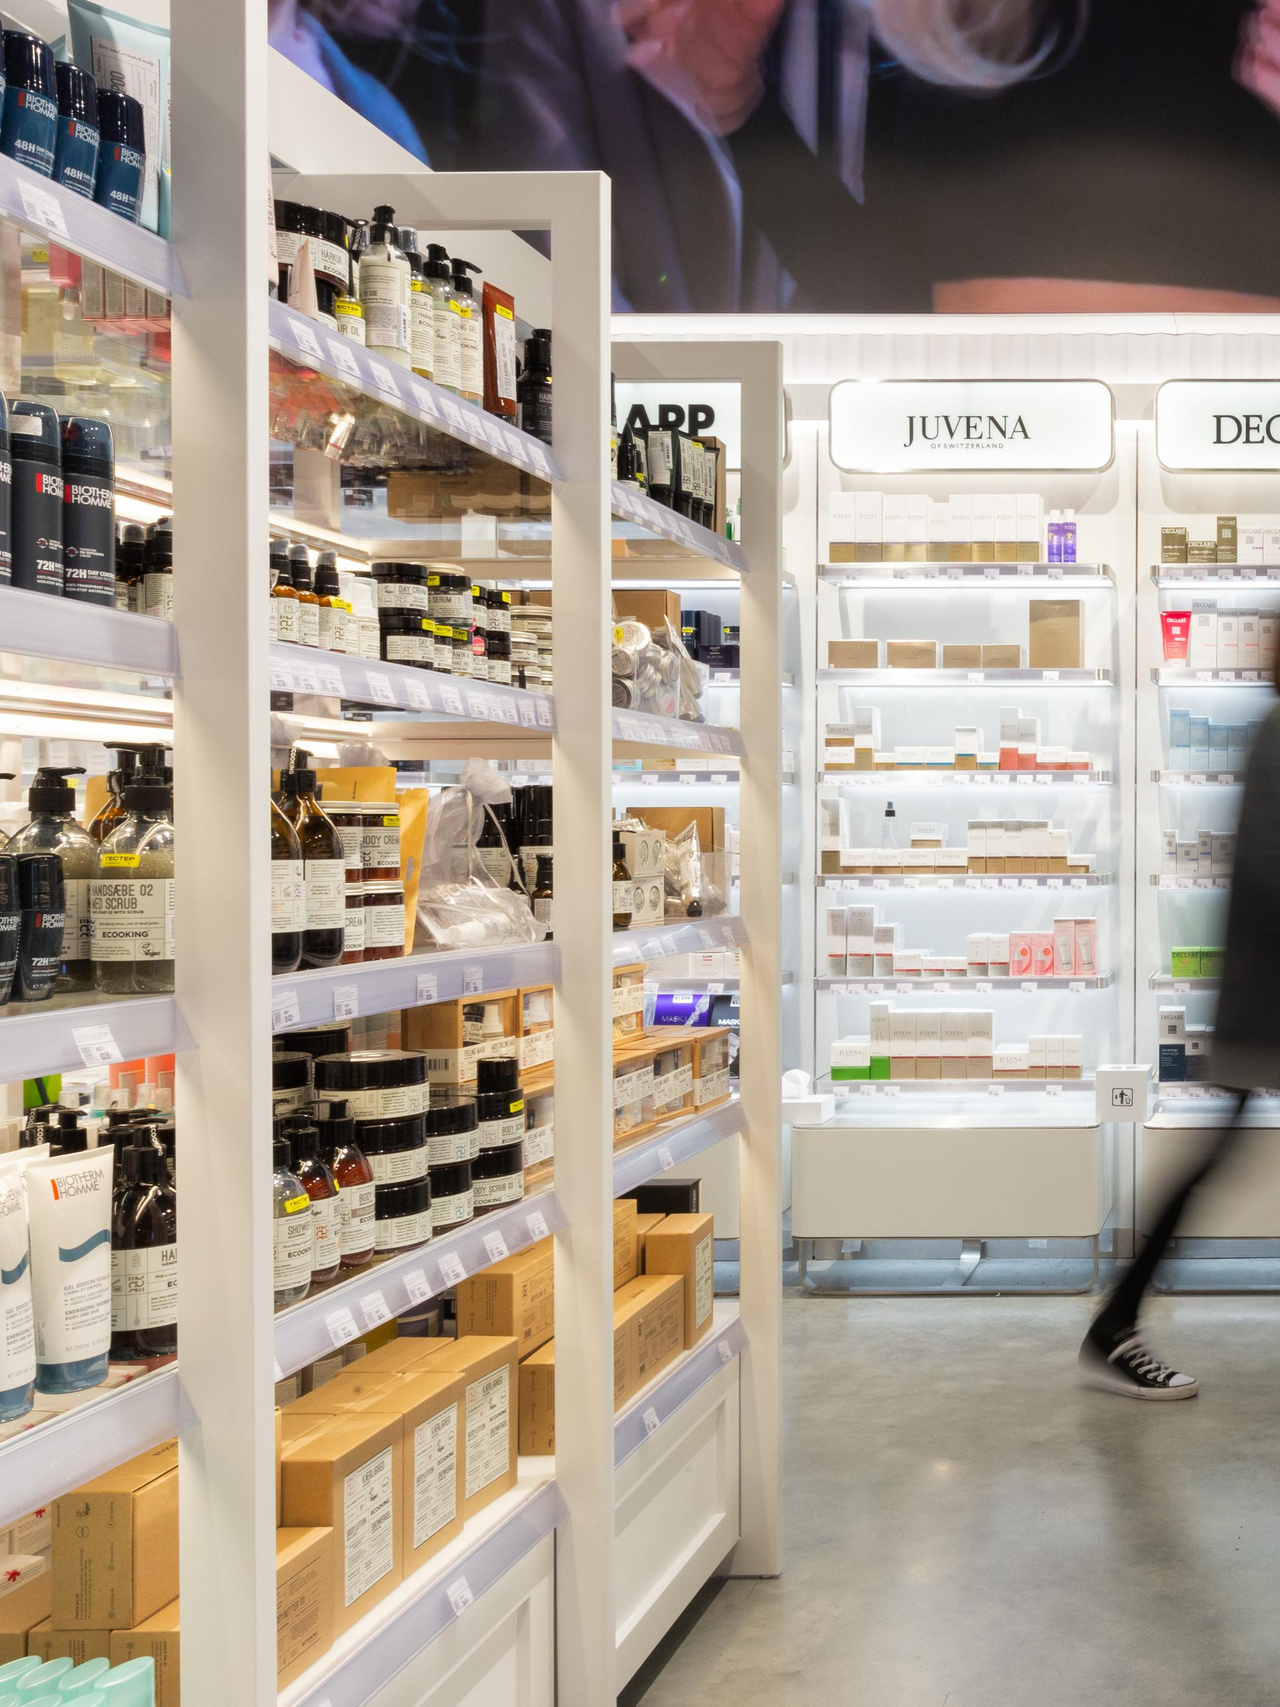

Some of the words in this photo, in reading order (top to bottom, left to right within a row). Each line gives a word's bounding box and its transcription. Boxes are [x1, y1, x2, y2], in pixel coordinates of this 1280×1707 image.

[14, 139, 36, 154] 48H
[64, 167, 83, 180] 48H
[110, 190, 129, 203] 48H
[351, 326, 361, 337] OIL
[903, 415, 1031, 448] JUVENA
[71, 494, 112, 509] HOMME
[36, 559, 54, 571] 72H
[65, 568, 87, 579] 72H
[140, 884, 154, 896] 02
[105, 897, 138, 910] SCRUB
[32, 958, 49, 966] 72H
[56, 1169, 105, 1188] BIOTHERM
[59, 1182, 100, 1200] HOMME
[488, 1183, 507, 1194] SCRUB
[473, 1197, 503, 1205] COOKING
[76, 1278, 96, 1288] DOUCHE
[65, 1304, 96, 1316] ENERGIZING
